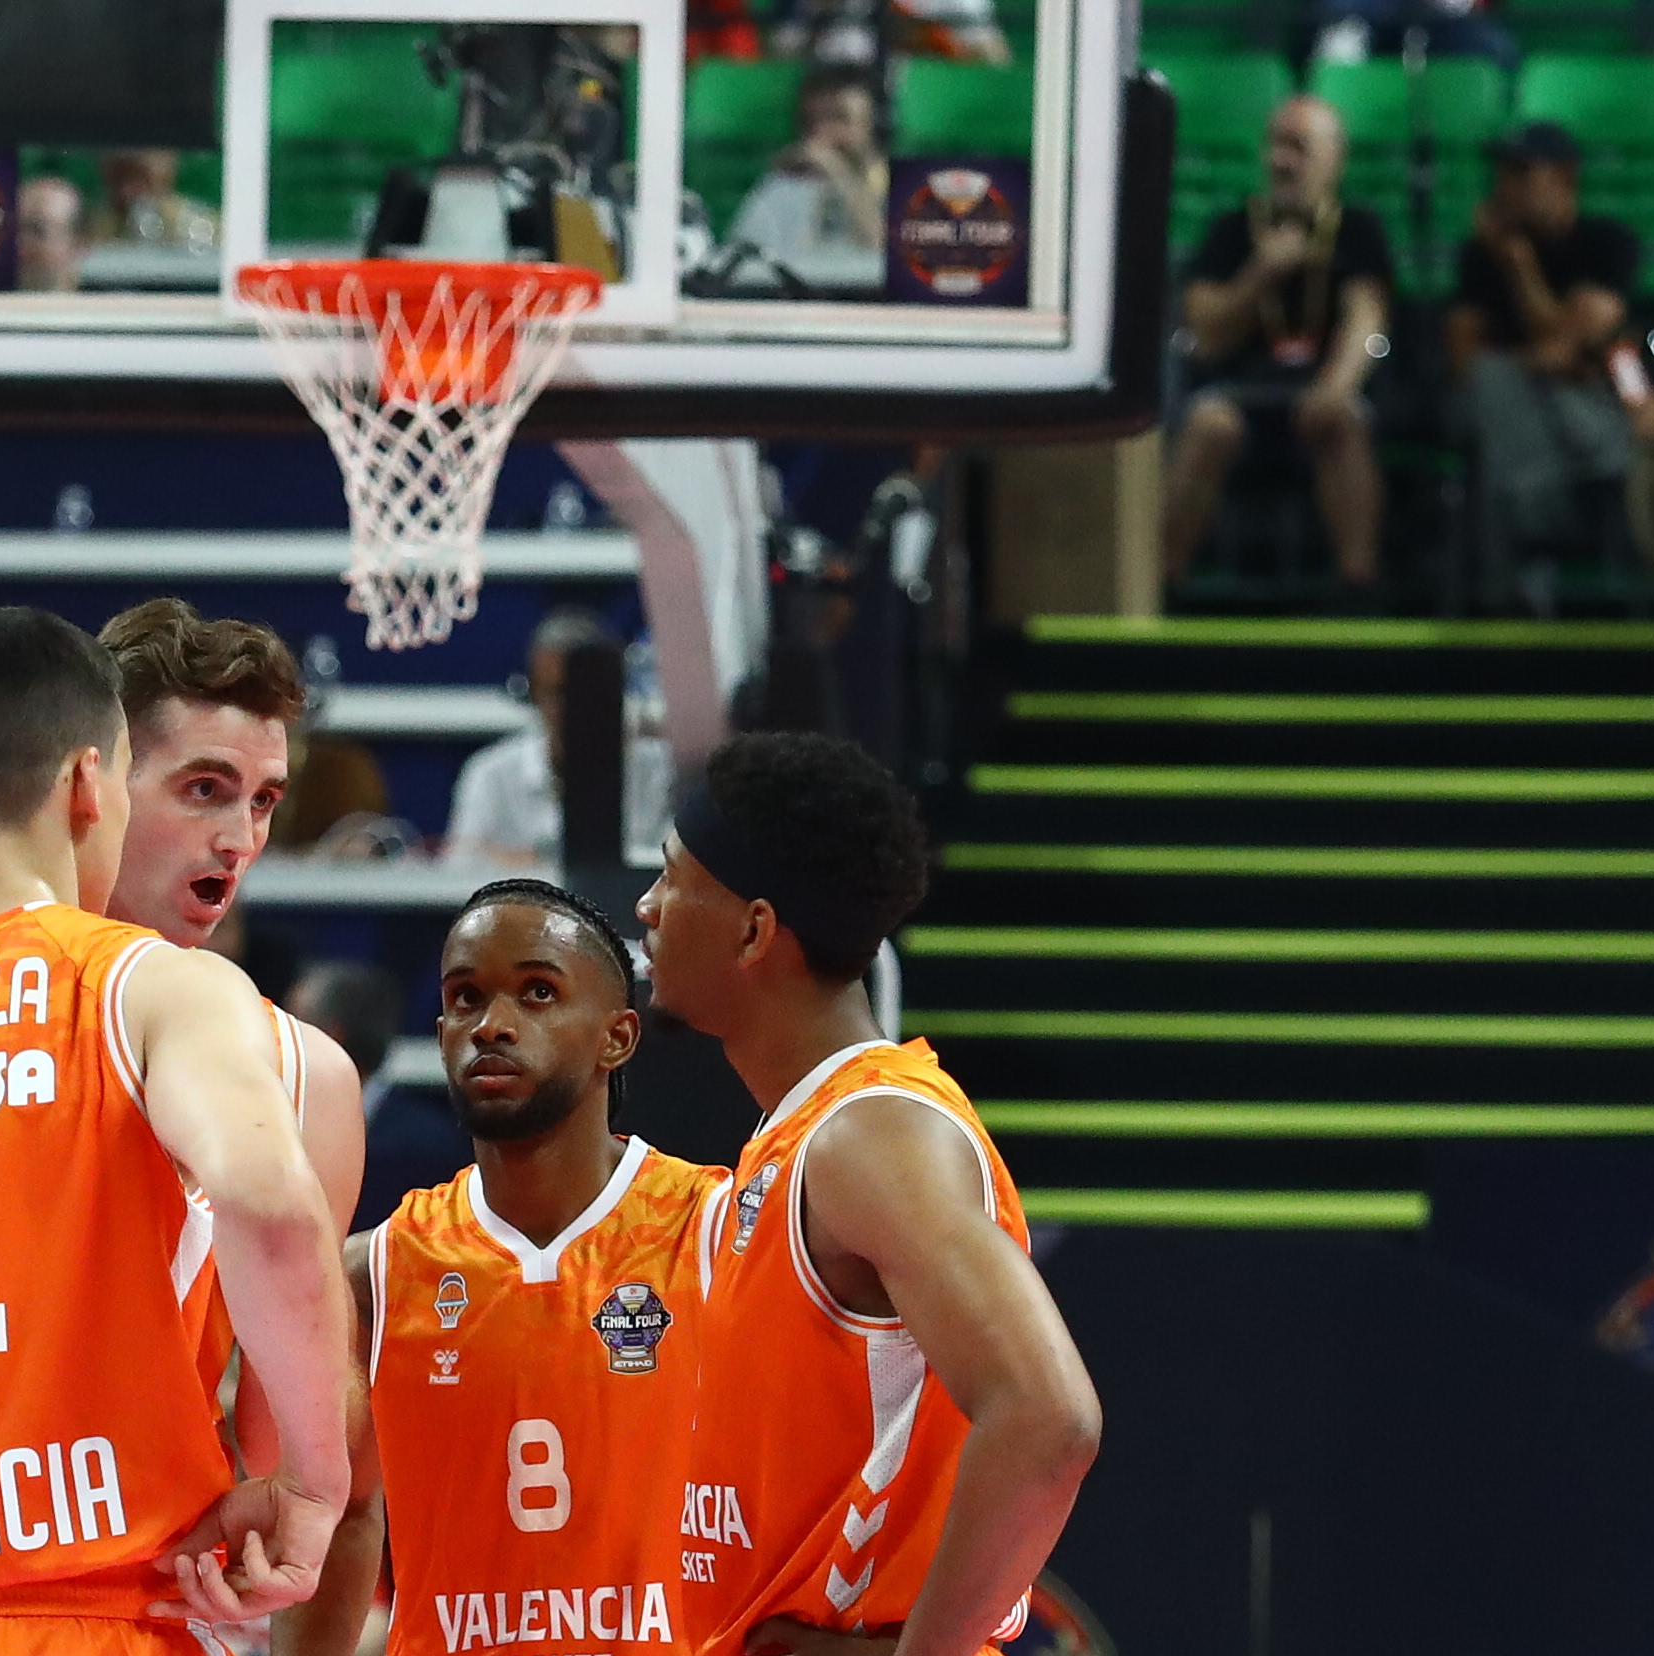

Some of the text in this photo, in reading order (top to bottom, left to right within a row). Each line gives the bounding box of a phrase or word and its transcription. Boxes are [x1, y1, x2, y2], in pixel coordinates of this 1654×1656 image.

[600, 1313, 663, 1329] FINAL FOUR
[506, 1418, 573, 1533] 8
[681, 1550, 717, 1583] SKET
[435, 1582, 674, 1653] VALENCIA
